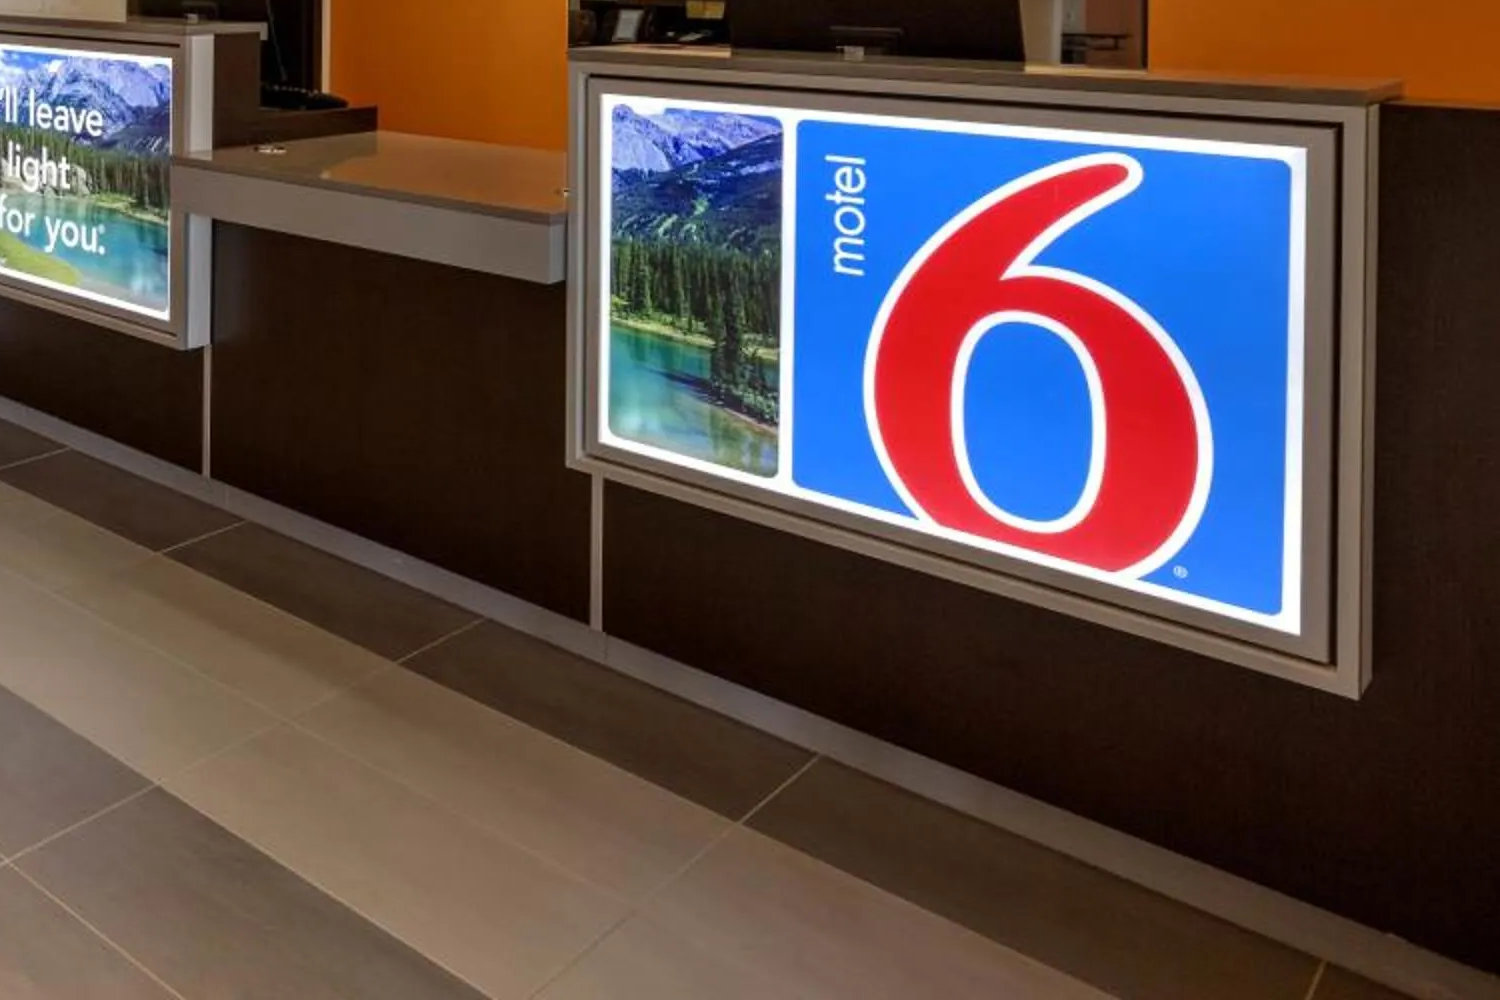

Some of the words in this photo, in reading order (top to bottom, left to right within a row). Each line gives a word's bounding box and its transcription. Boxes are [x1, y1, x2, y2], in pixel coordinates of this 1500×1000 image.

[29, 88, 104, 137] leave
[7, 140, 70, 193] light
[826, 154, 867, 277] motel
[863, 152, 1214, 583] 6
